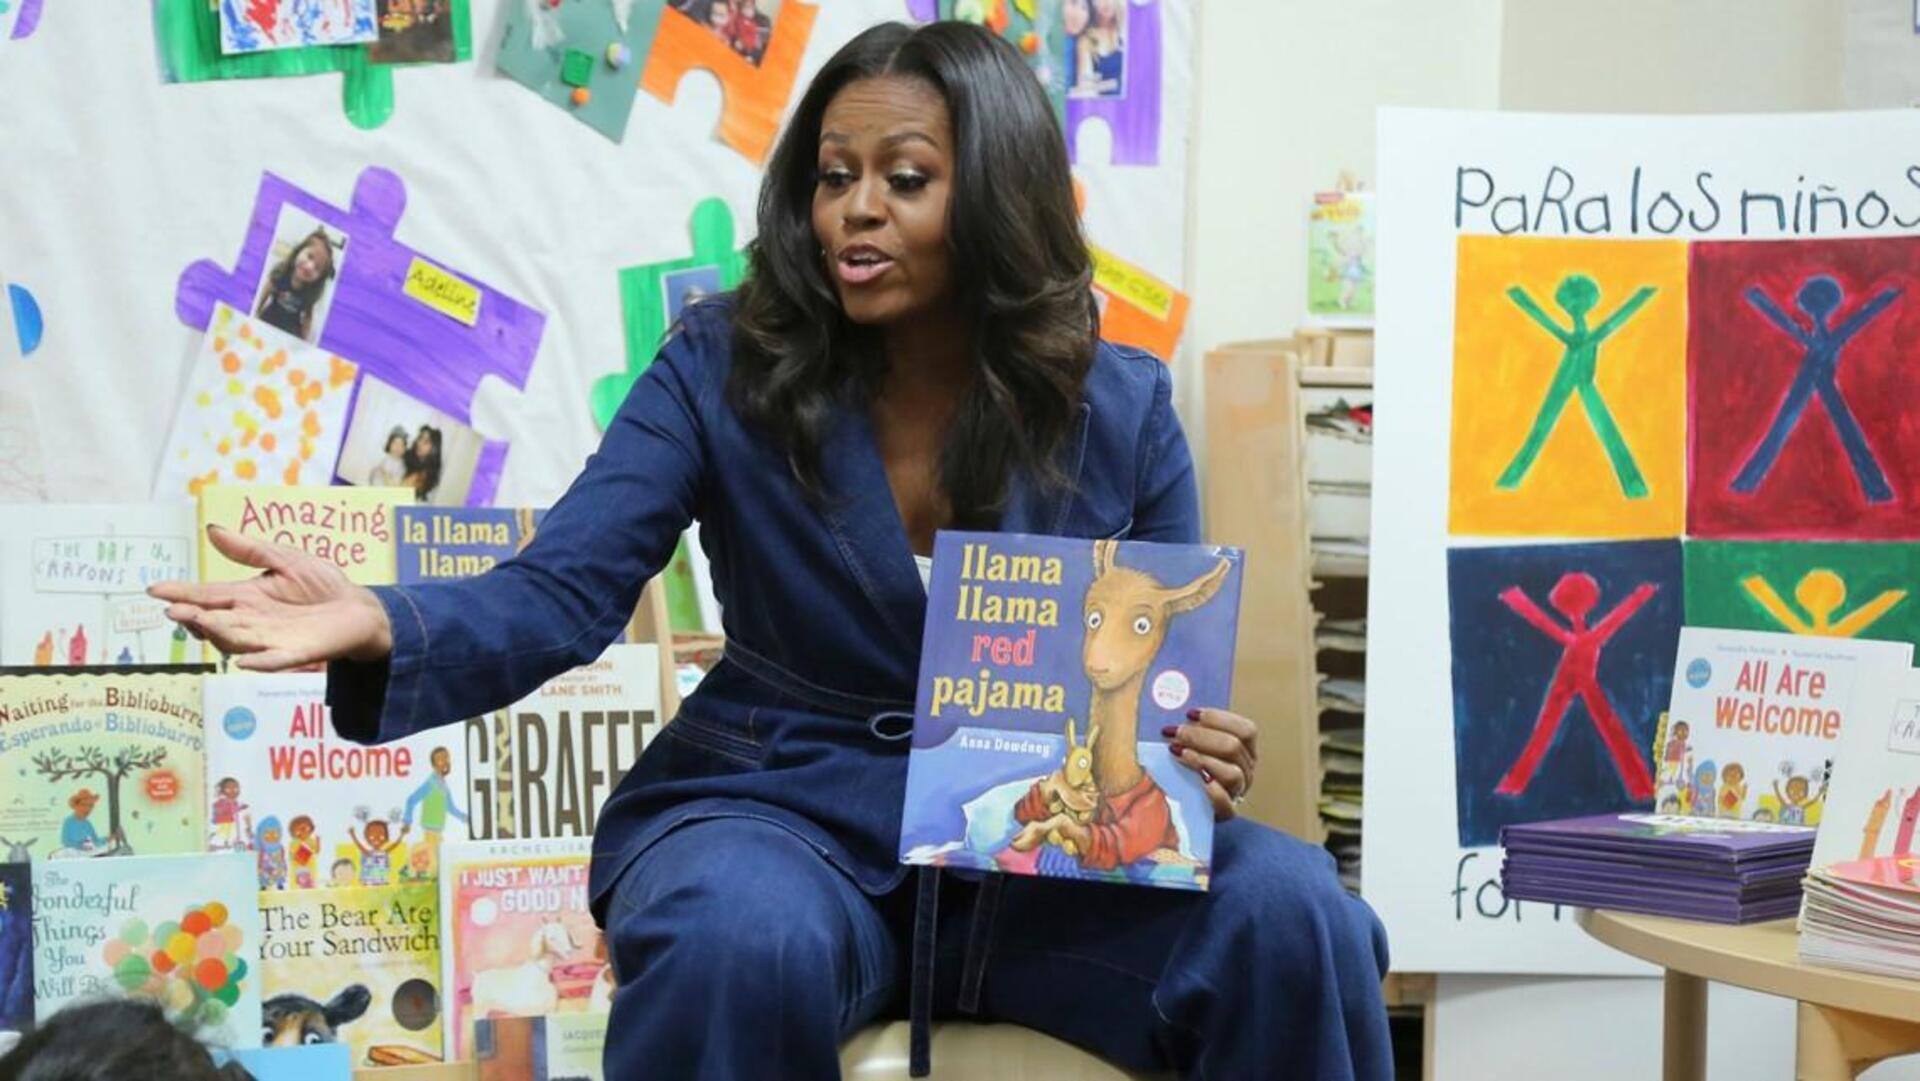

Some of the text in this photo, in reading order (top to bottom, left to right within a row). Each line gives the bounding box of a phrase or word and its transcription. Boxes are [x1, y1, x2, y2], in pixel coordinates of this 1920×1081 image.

[240, 496, 390, 543] Amazing
[403, 514, 511, 546] la llama
[960, 544, 1063, 585] llama
[955, 585, 1059, 626] llama
[971, 629, 1036, 666] red
[930, 669, 1066, 717] pajama
[1736, 660, 1826, 699] All Are
[290, 702, 324, 738] All
[1715, 697, 1841, 739] Welcome
[269, 743, 412, 781] Welcome
[960, 735, 1051, 759] Anna Dowdney
[461, 864, 585, 887] I JUST WANT
[258, 906, 310, 932] The
[321, 902, 379, 929] Bear
[502, 888, 561, 911] GOOD
[322, 926, 440, 957] Sandwich
[44, 946, 86, 974] You
